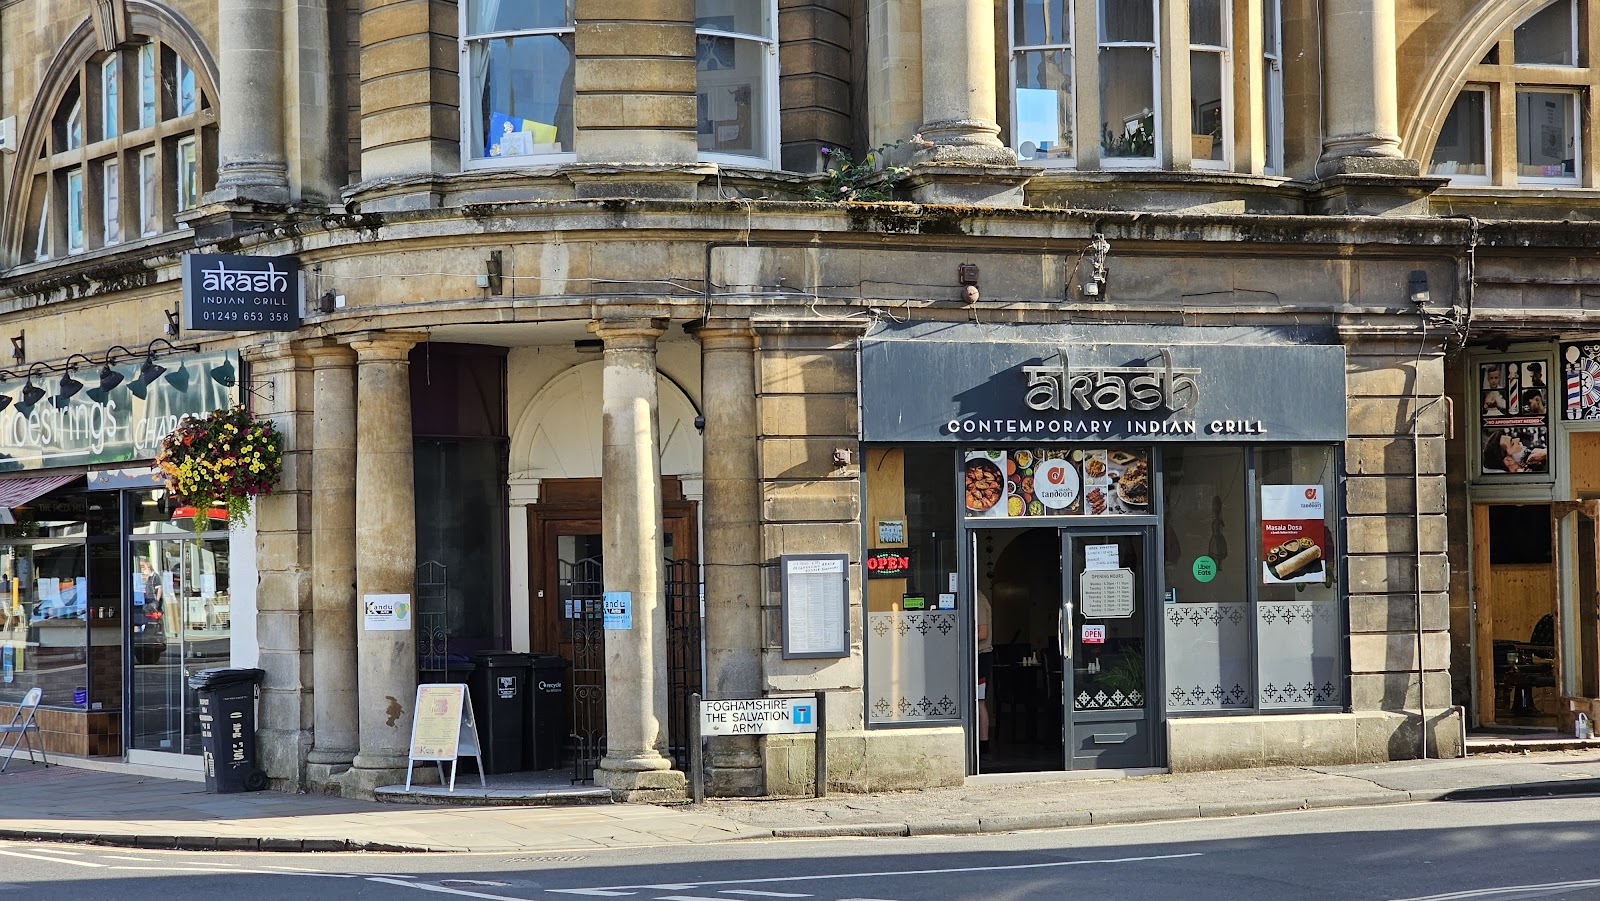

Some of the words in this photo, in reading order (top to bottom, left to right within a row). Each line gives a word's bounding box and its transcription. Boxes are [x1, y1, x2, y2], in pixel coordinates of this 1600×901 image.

[201, 260, 288, 292] akash
[202, 296, 245, 304] INDIAN
[254, 297, 288, 306] GRILL
[203, 311, 238, 321] 01249
[244, 312, 263, 321] 653
[270, 312, 289, 321] 358
[1021, 348, 1202, 412] akash
[948, 420, 1112, 434] CONTEMPORARY
[1128, 420, 1197, 434] INDIAN
[1210, 420, 1268, 434] GRILL
[1042, 490, 1073, 498] tandoori
[867, 556, 909, 570] OPEN
[365, 602, 392, 614] Kandu
[706, 700, 787, 711] FOGHAMSHIRE
[706, 713, 727, 722] THE
[732, 711, 789, 722] SALVATION
[732, 723, 763, 733] ARMY
